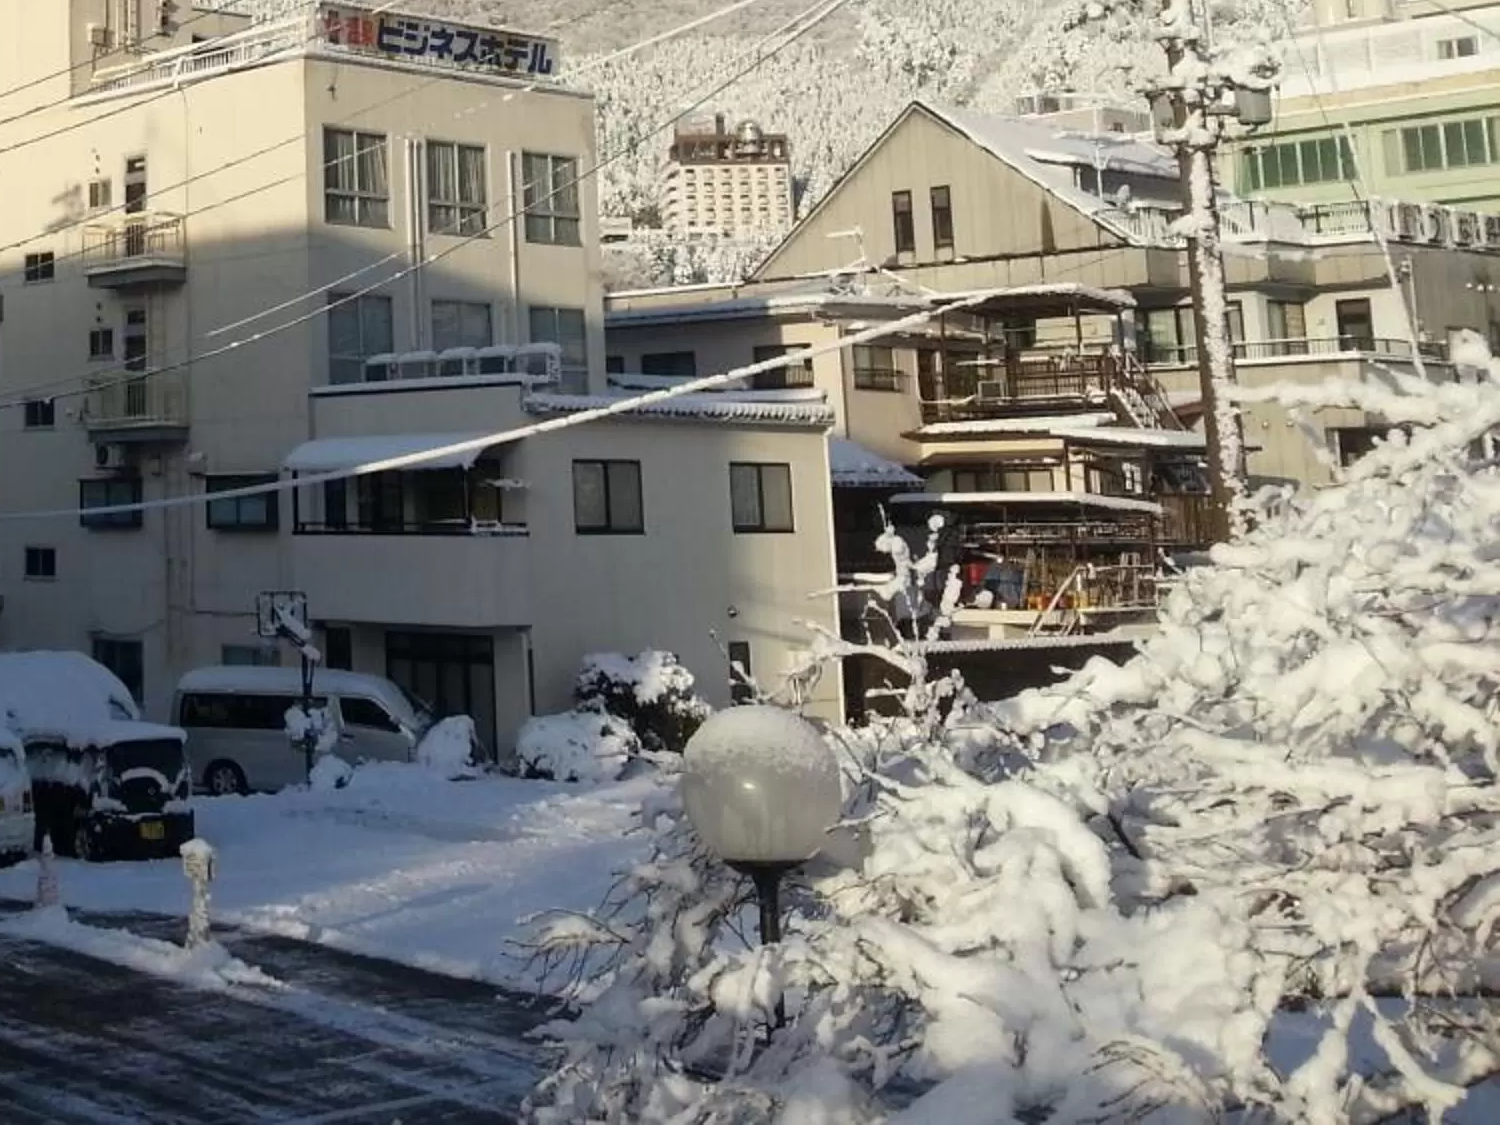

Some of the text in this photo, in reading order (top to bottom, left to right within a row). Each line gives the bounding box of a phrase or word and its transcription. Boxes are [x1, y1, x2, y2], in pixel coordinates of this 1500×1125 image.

[377, 17, 552, 74] ビジネスホテル
